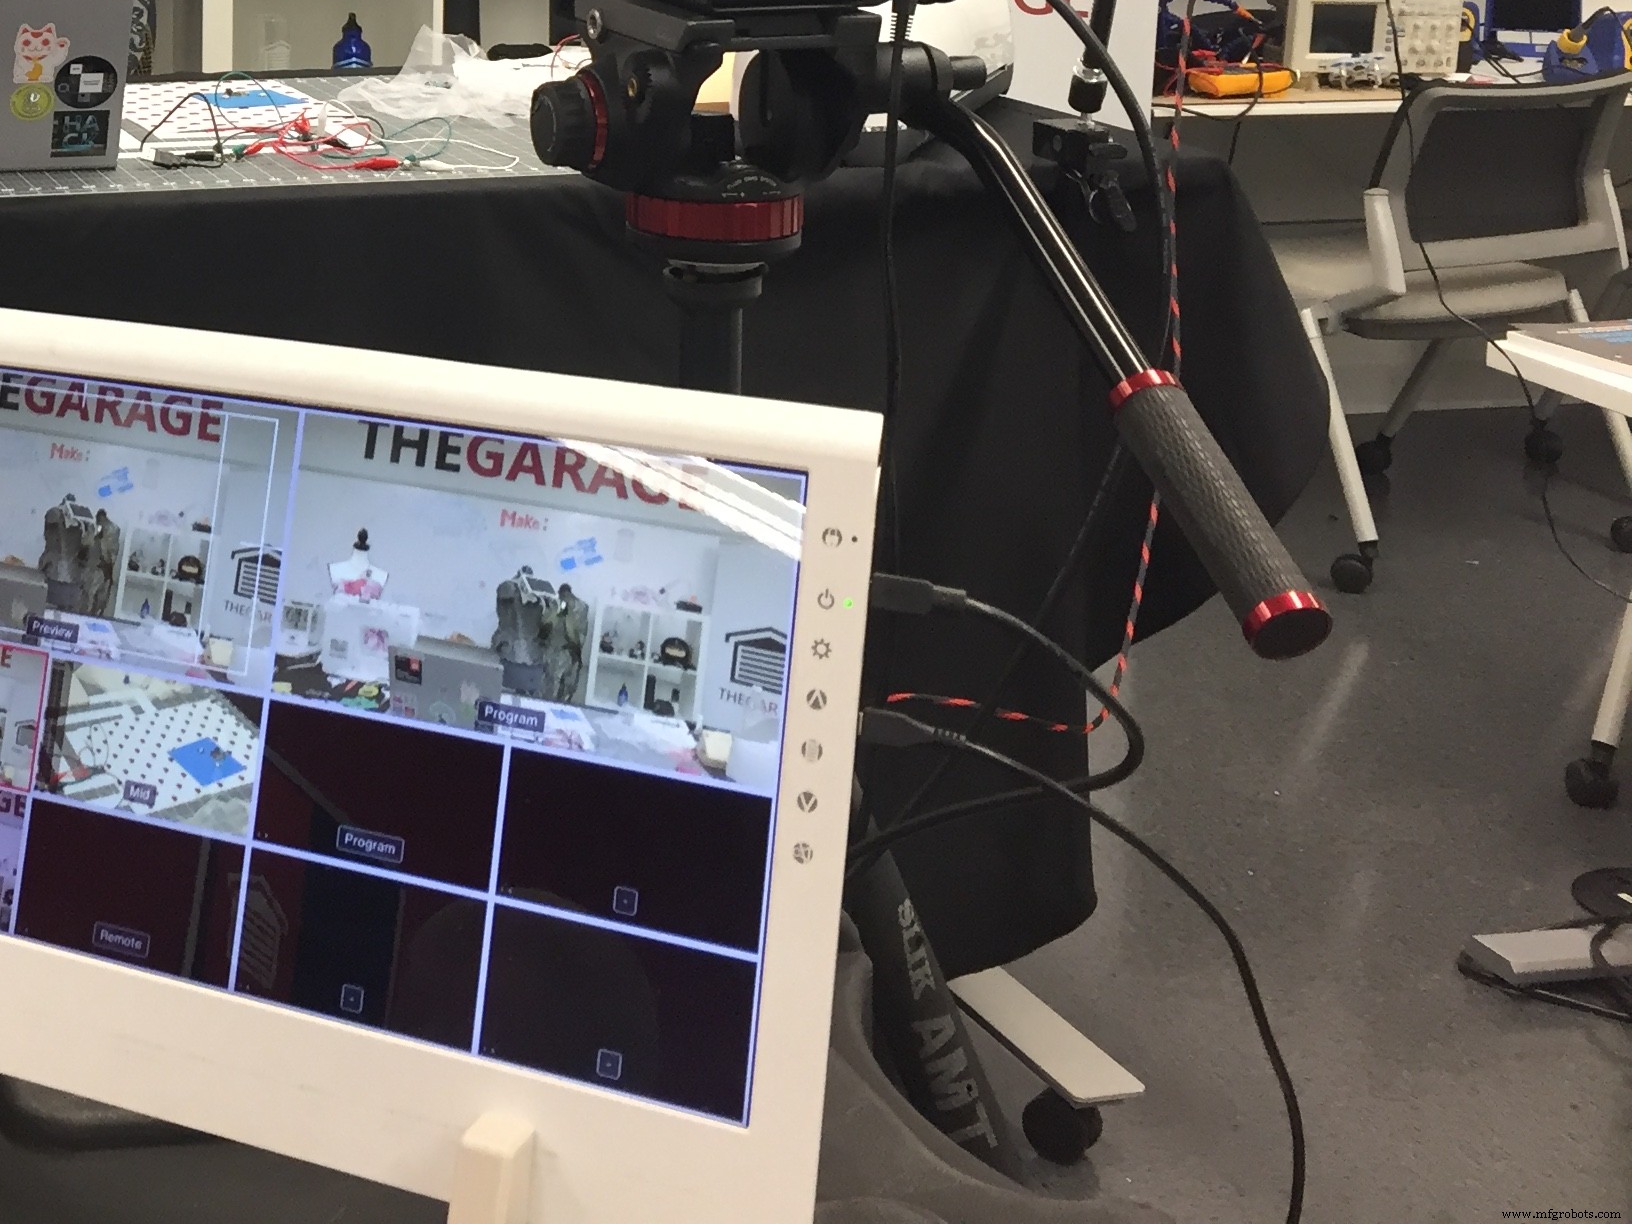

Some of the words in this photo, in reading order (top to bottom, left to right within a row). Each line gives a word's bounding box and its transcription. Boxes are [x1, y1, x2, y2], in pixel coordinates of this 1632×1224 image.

[31, 619, 74, 638] Preview
[484, 703, 539, 727] Program
[129, 785, 151, 802] Mid
[344, 831, 397, 856] Program
[99, 928, 144, 951] Remote
